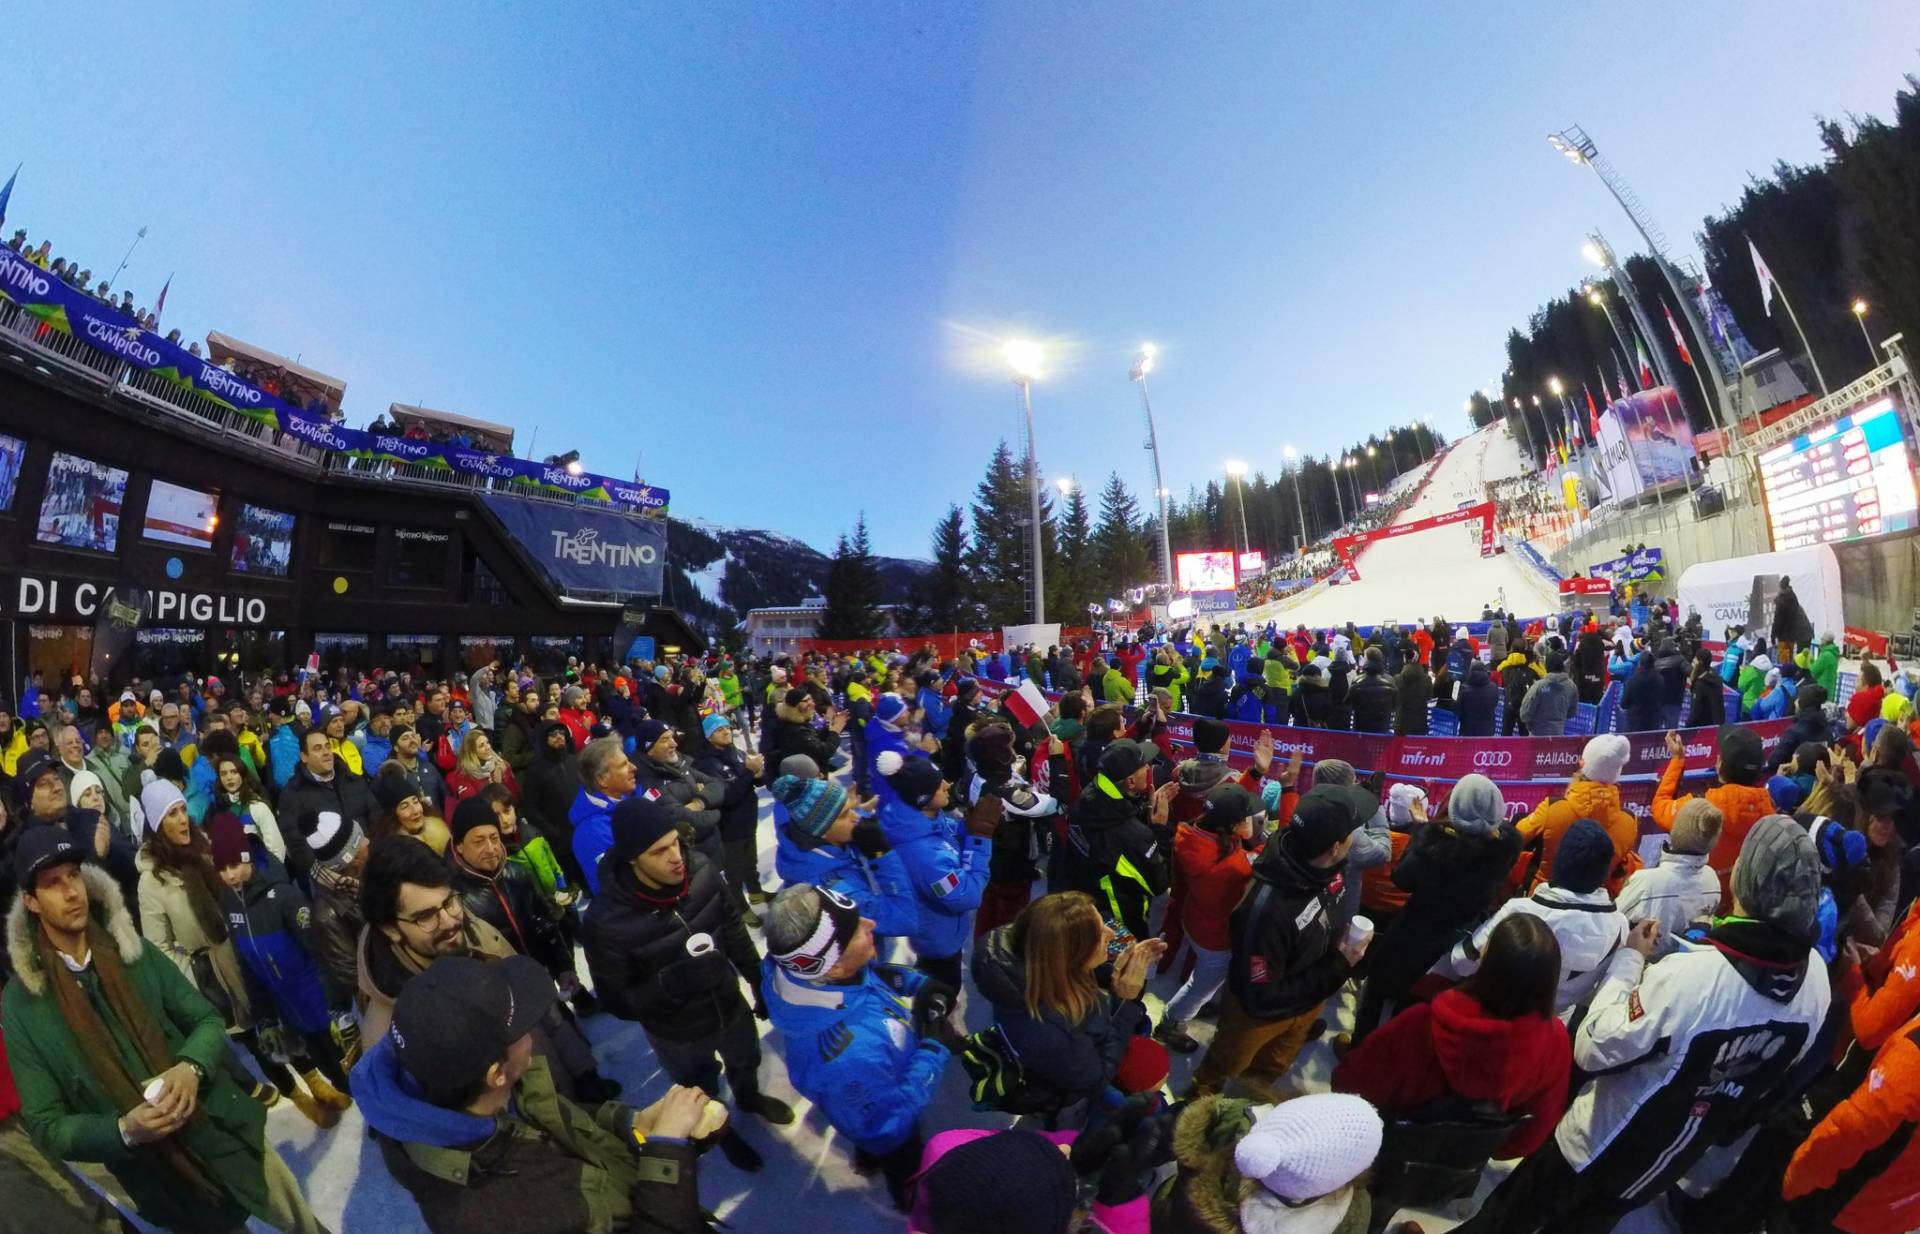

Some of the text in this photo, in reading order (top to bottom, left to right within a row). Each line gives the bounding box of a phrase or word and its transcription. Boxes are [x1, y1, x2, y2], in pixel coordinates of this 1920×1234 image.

[87, 321, 160, 366] CAMPIGLIO
[200, 363, 261, 403] TRENTINO
[289, 418, 346, 450] CAMPIGLIO
[376, 435, 428, 455] TRENTINO
[460, 458, 514, 478] CAMPIGLIO
[543, 467, 591, 487] TRENTINO
[619, 491, 664, 506] CAMPIGLIO
[551, 530, 656, 568] TRENTINO
[18, 577, 266, 623] DI CPIGLIO
[136, 630, 204, 644] TRENTINO TRENTINO
[1695, 1080, 1744, 1099] TEAM
